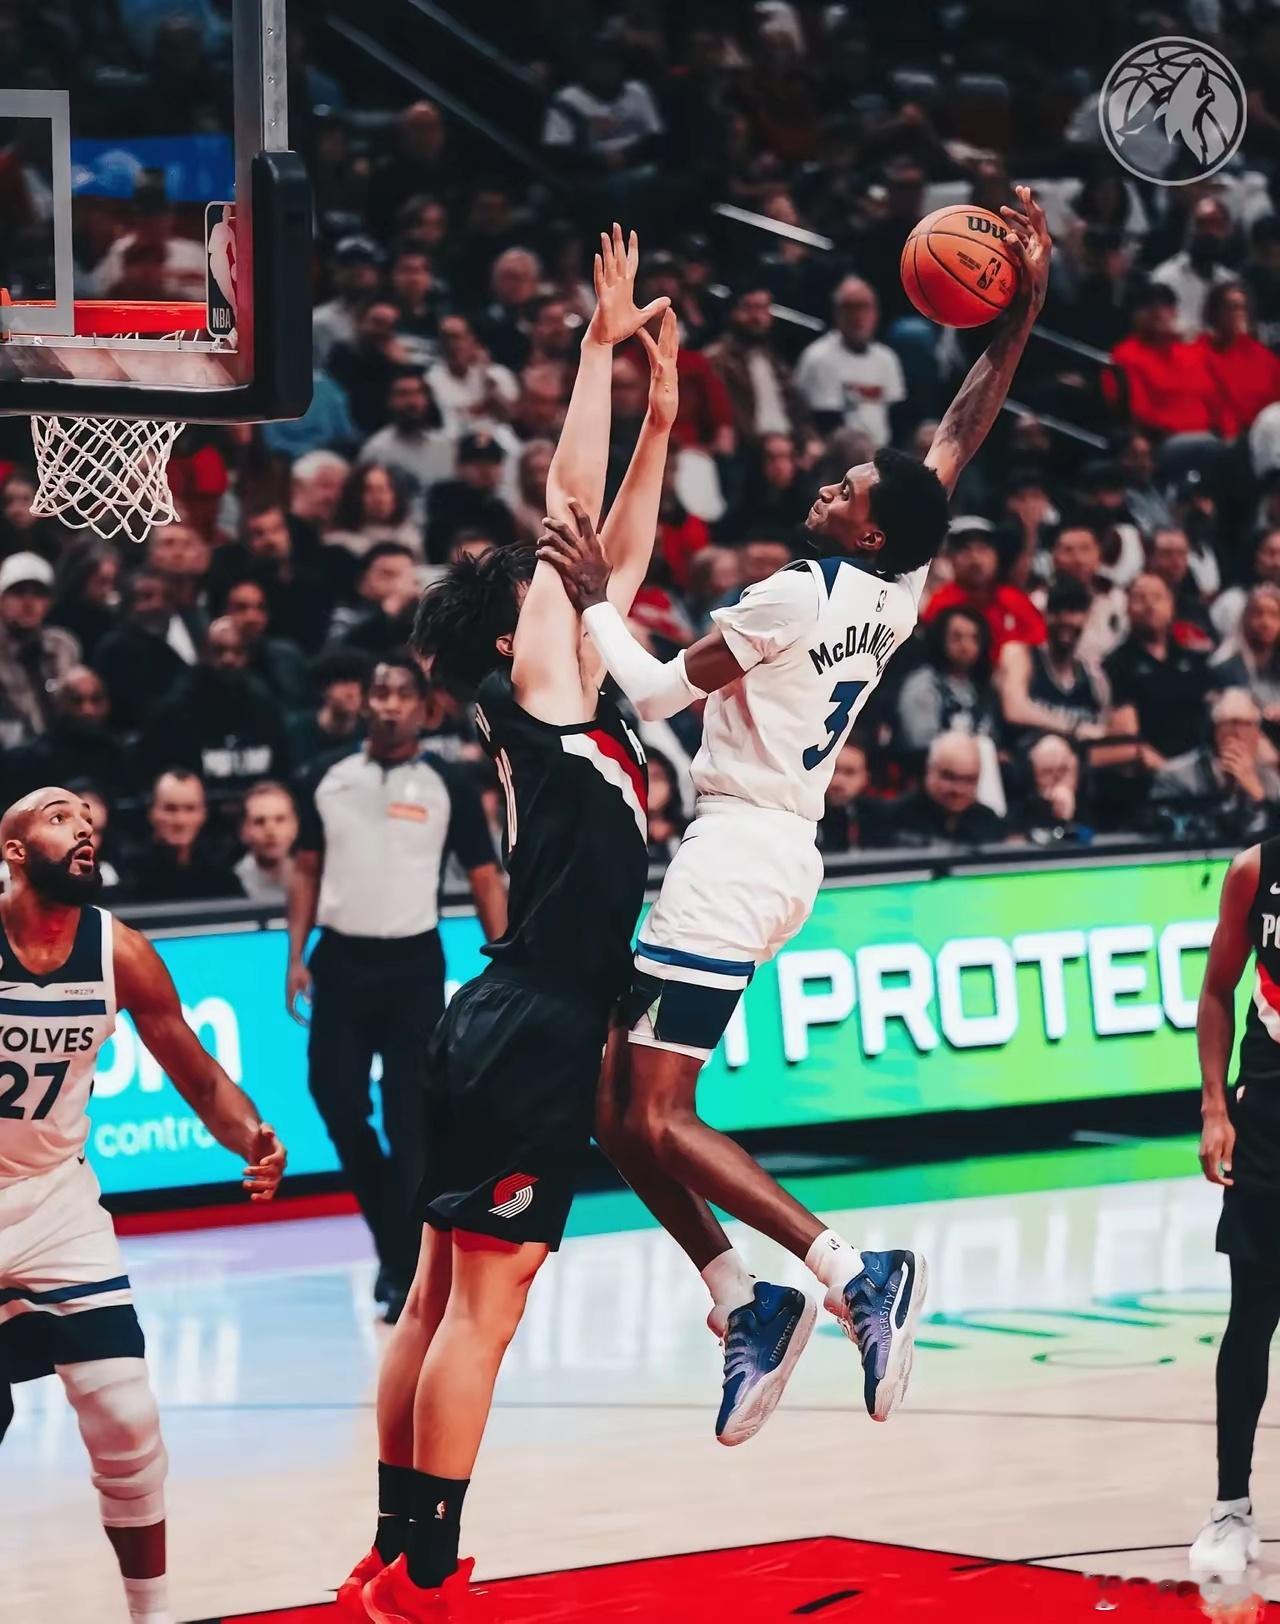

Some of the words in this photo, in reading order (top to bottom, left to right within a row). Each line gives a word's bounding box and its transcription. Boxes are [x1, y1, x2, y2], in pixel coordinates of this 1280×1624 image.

[212, 307, 231, 329] NBA
[802, 680, 870, 771] 3
[776, 920, 1217, 1063] PROTEC
[0, 1060, 70, 1120] 27
[879, 1293, 896, 1352] UNIVERSITY
